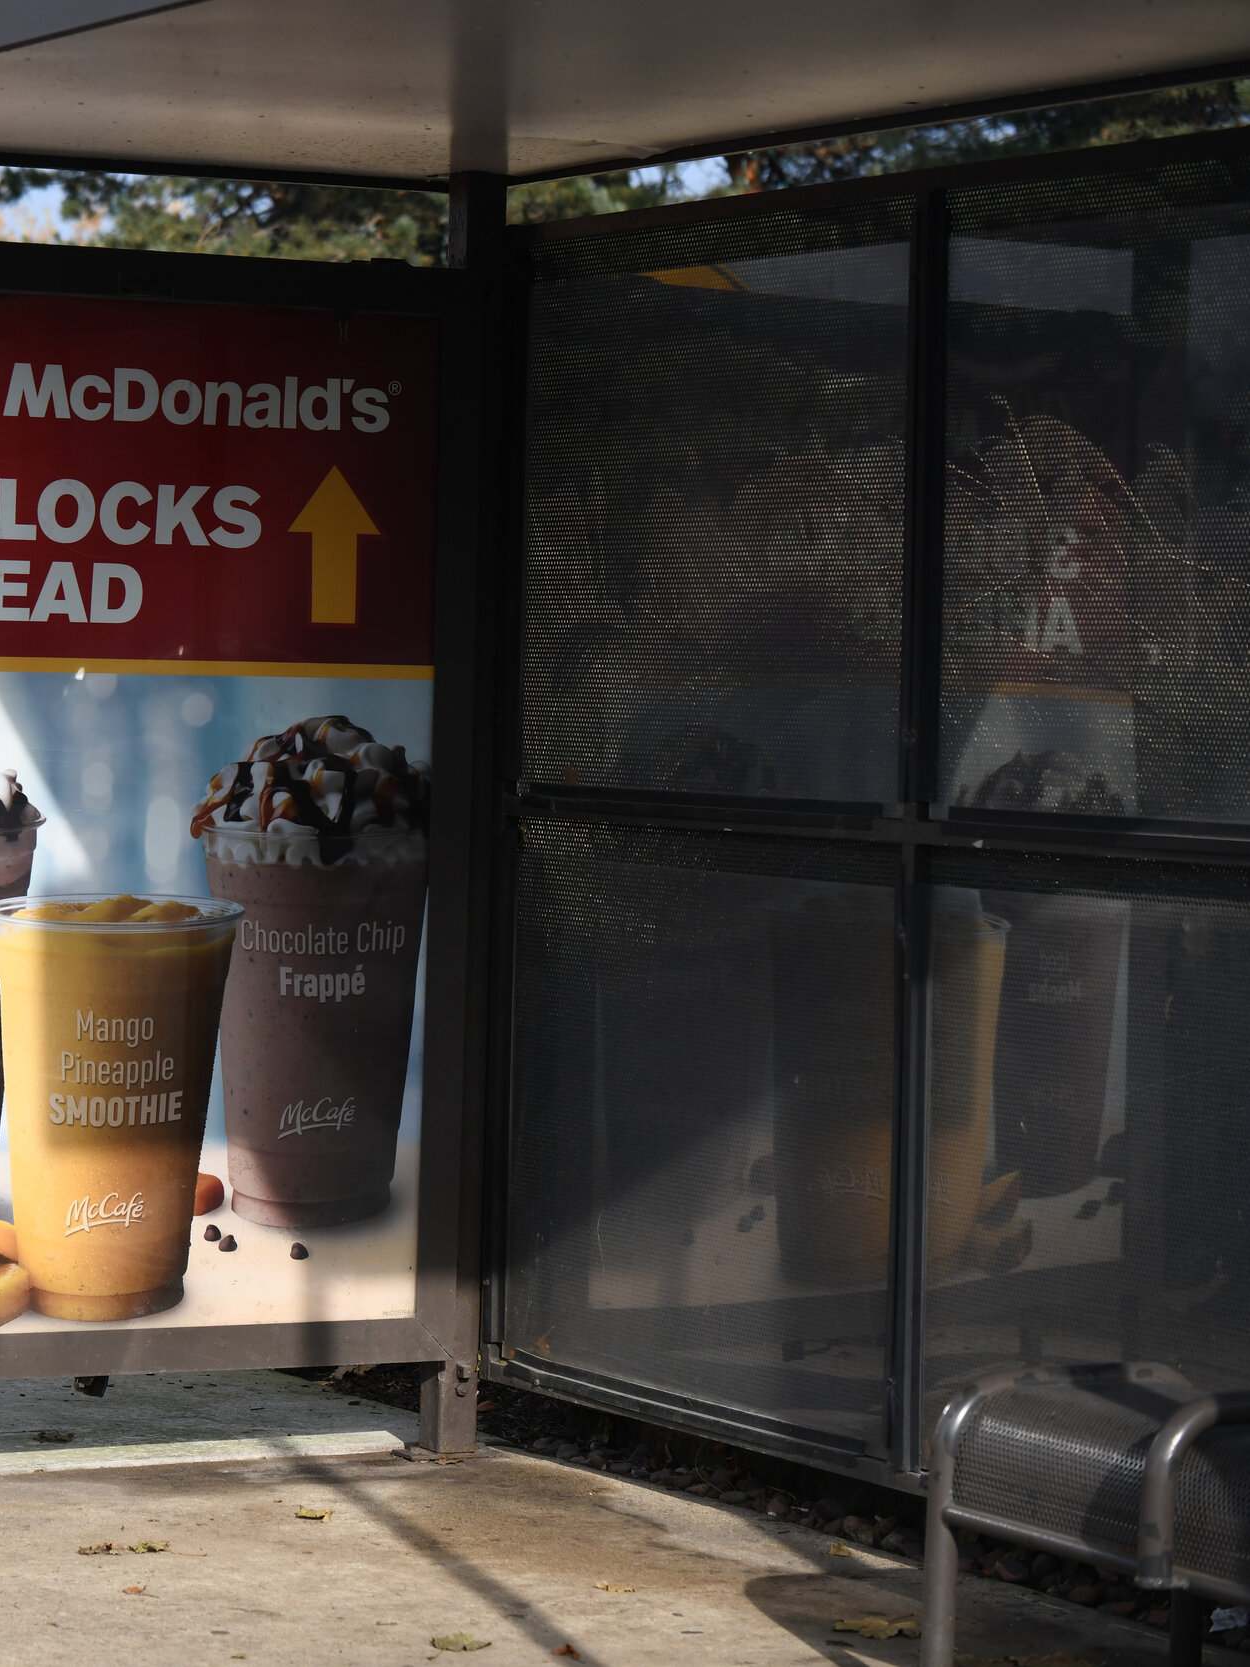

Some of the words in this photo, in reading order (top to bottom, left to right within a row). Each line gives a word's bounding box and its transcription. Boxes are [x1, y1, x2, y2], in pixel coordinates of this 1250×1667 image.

[241, 920, 350, 956] Chocolate
[356, 919, 407, 955] Chip
[279, 964, 366, 1003] Frappé
[75, 1009, 155, 1045] Mango
[60, 1051, 175, 1090] Pineapple
[49, 1090, 184, 1129] SMOOTHIE
[277, 1096, 356, 1140] McCafé
[64, 1191, 145, 1238] McCafé
